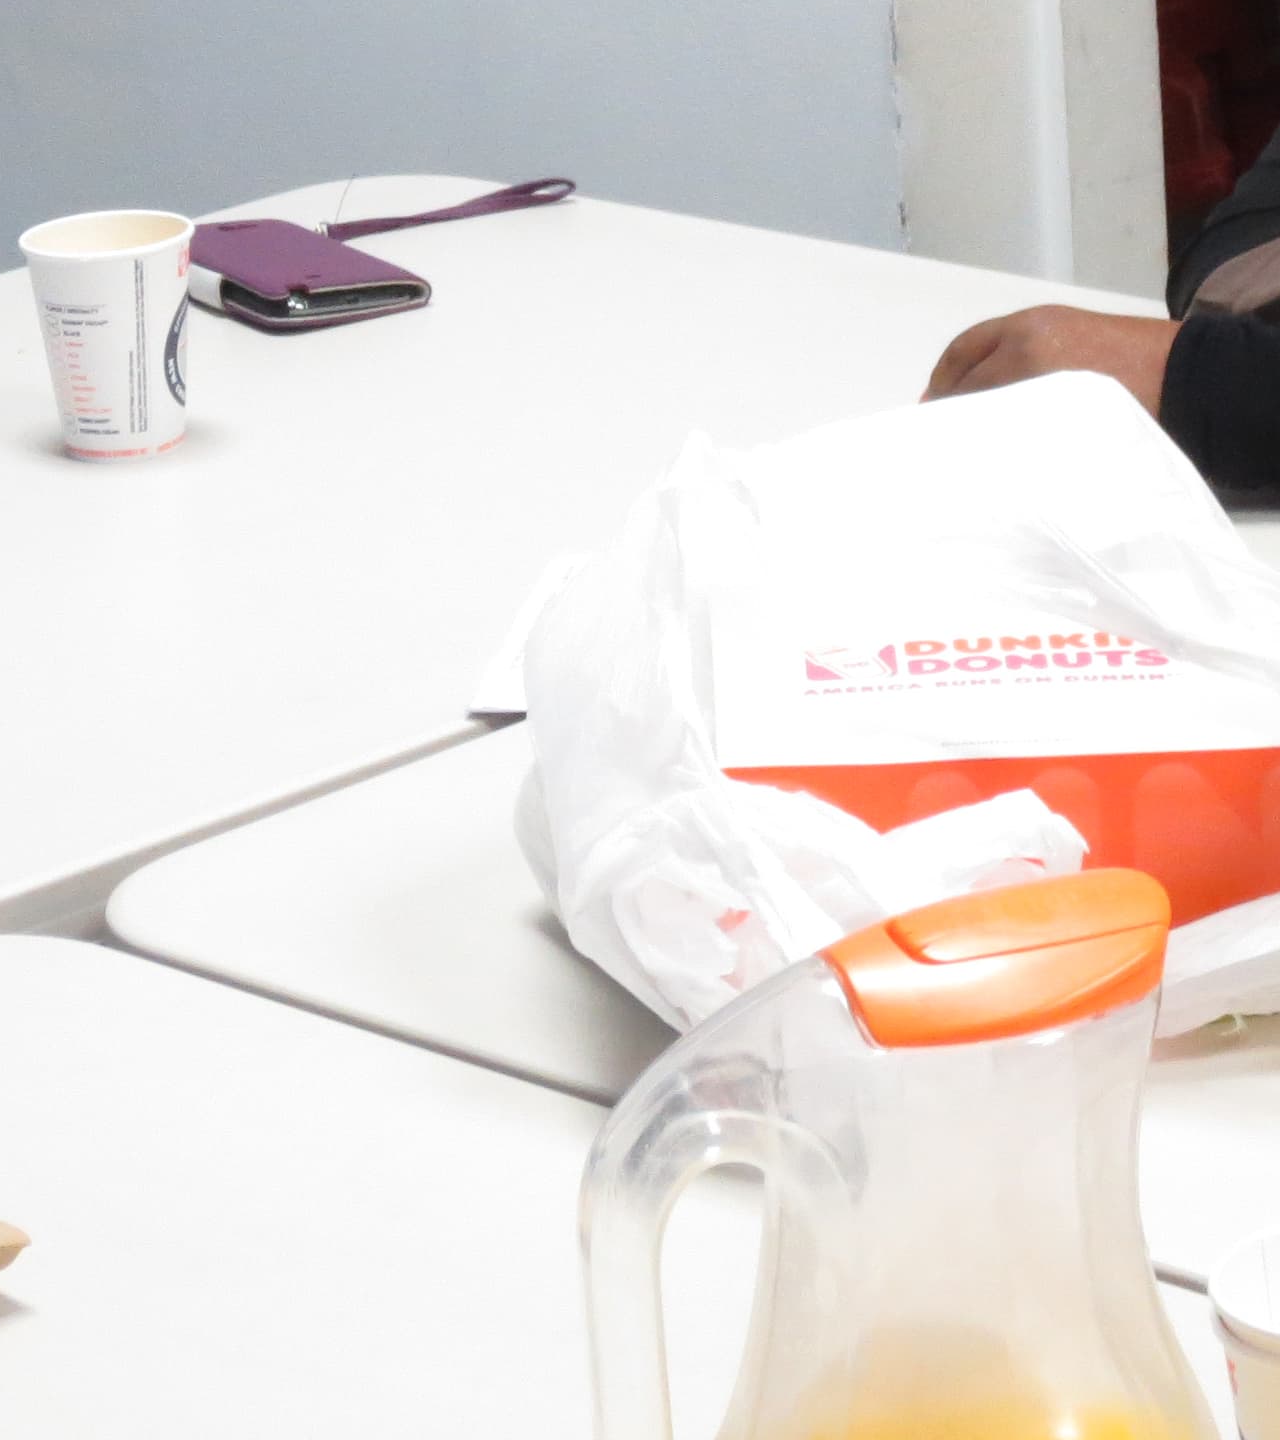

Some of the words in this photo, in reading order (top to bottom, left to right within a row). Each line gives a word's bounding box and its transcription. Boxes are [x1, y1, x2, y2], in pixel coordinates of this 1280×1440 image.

[907, 648, 1169, 676] DONUTS
[804, 682, 922, 696] AMERICA
[934, 678, 1001, 688] RUNS
[1014, 675, 1052, 685] ON
